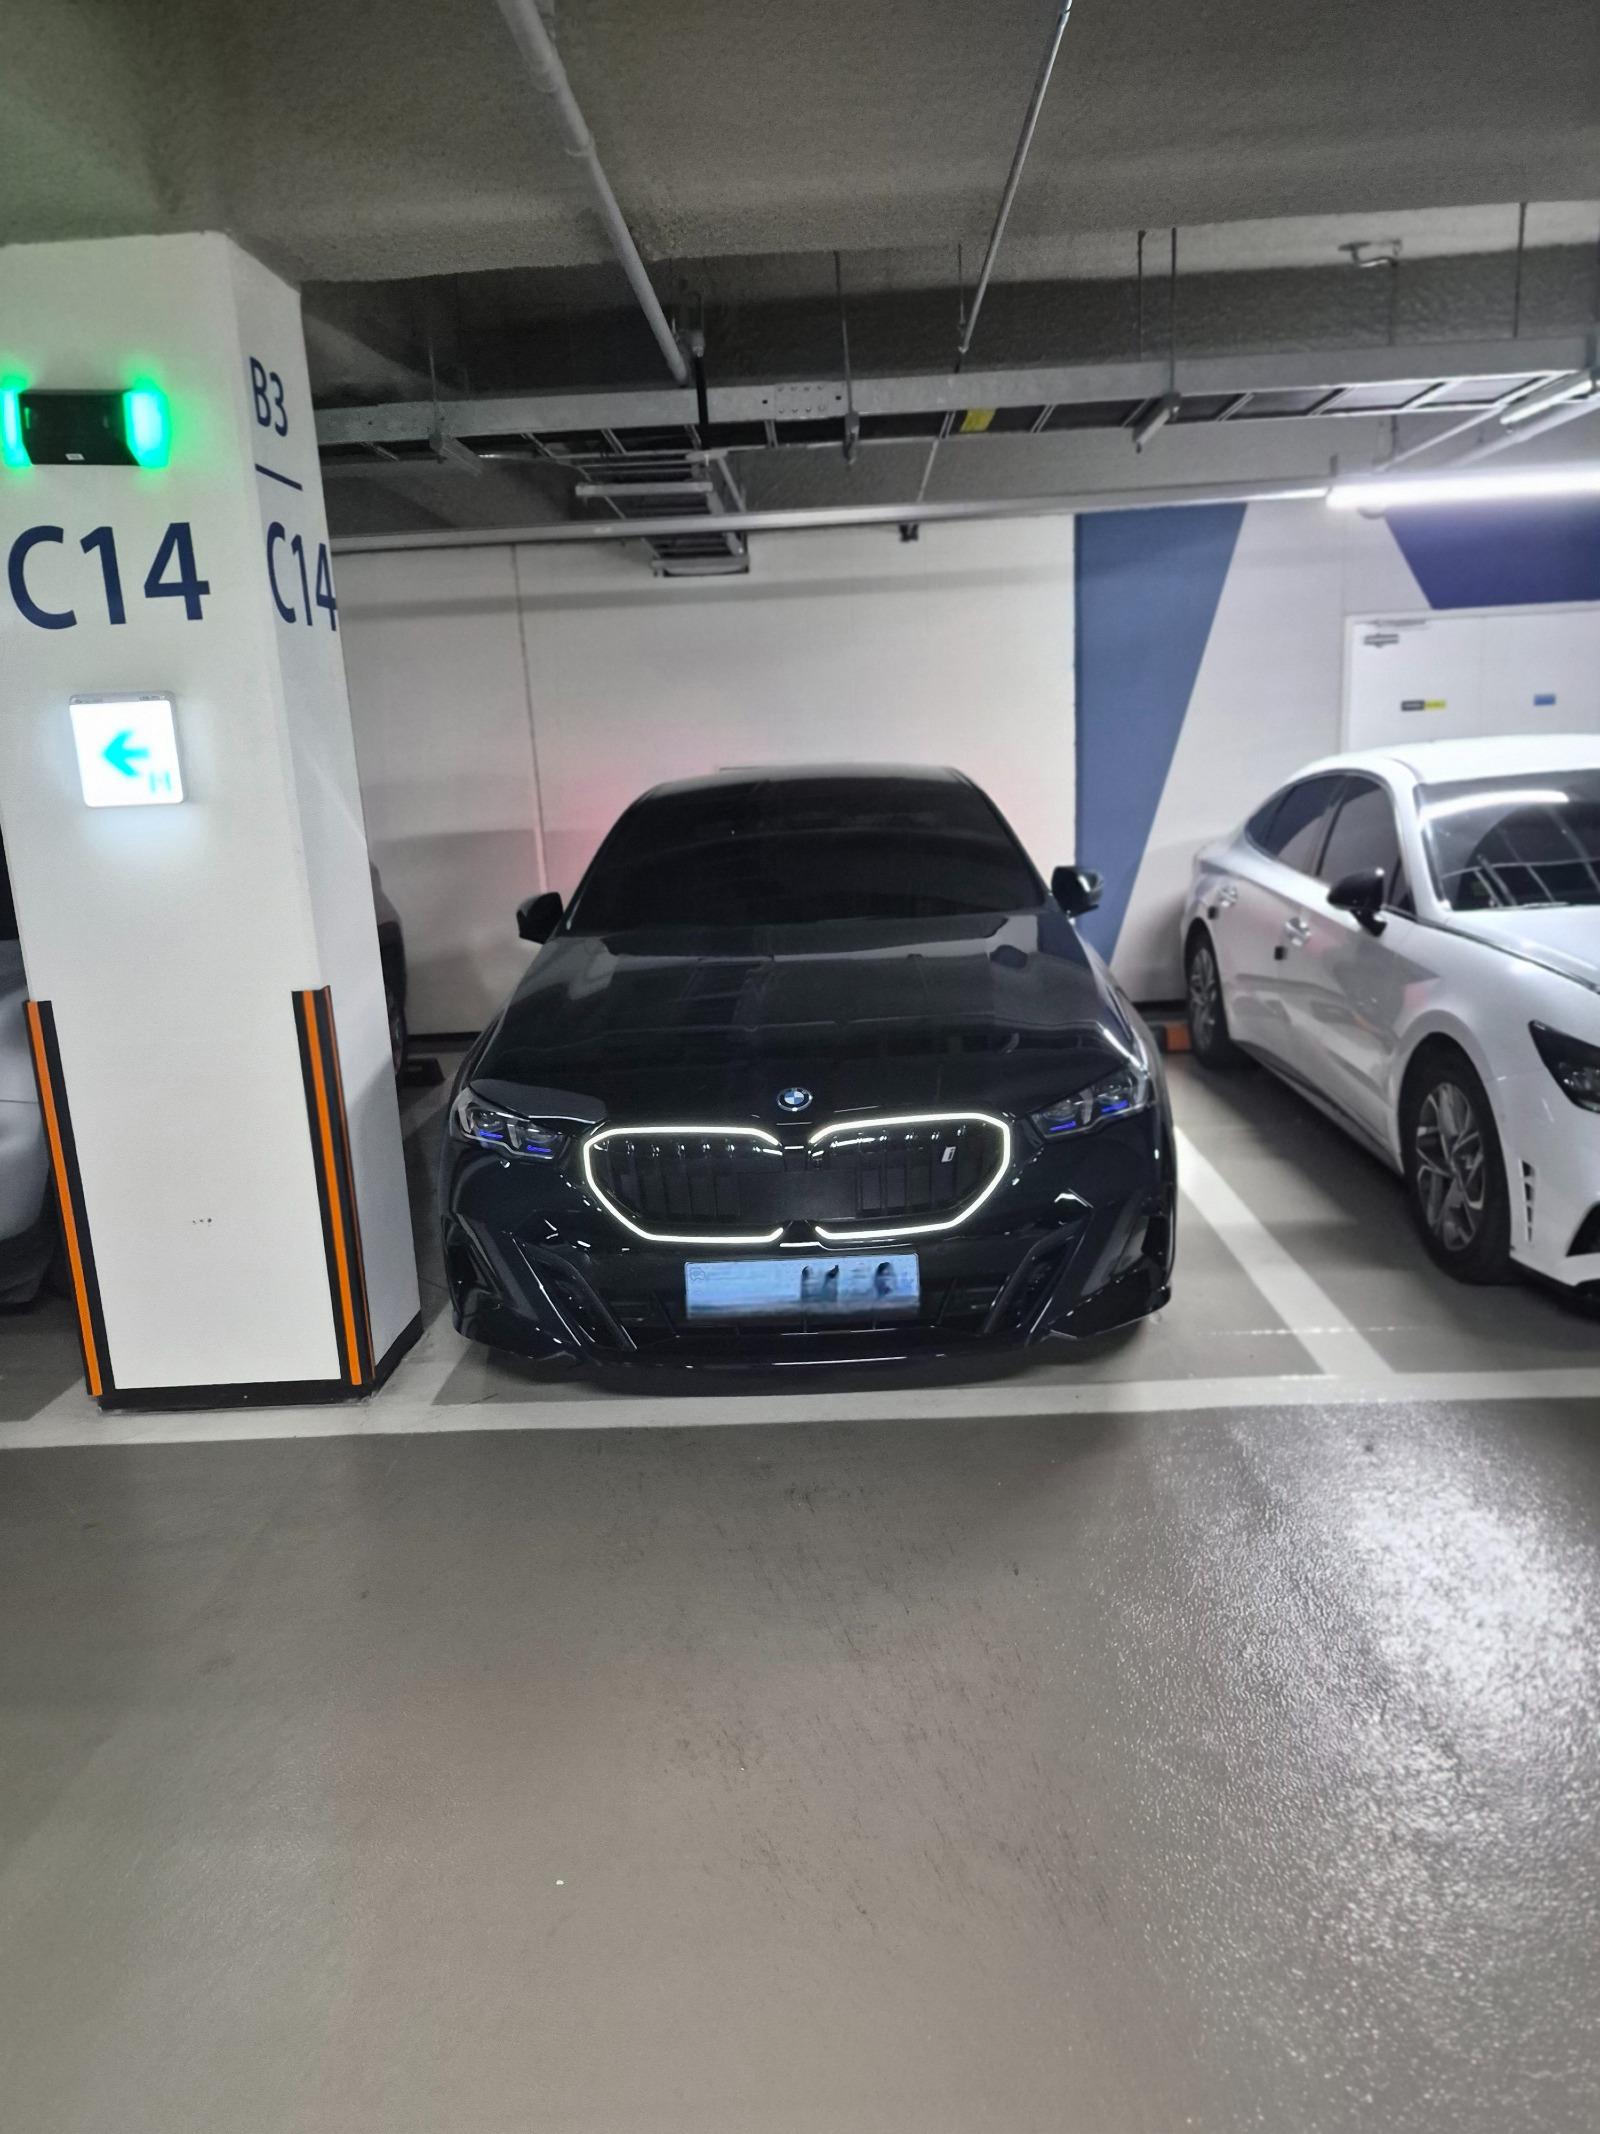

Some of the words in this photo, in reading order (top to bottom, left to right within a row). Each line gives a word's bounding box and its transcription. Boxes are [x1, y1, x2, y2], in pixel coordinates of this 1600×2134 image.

[249, 355, 289, 438] B3
[7, 521, 211, 630] C14
[266, 520, 337, 632] C14
